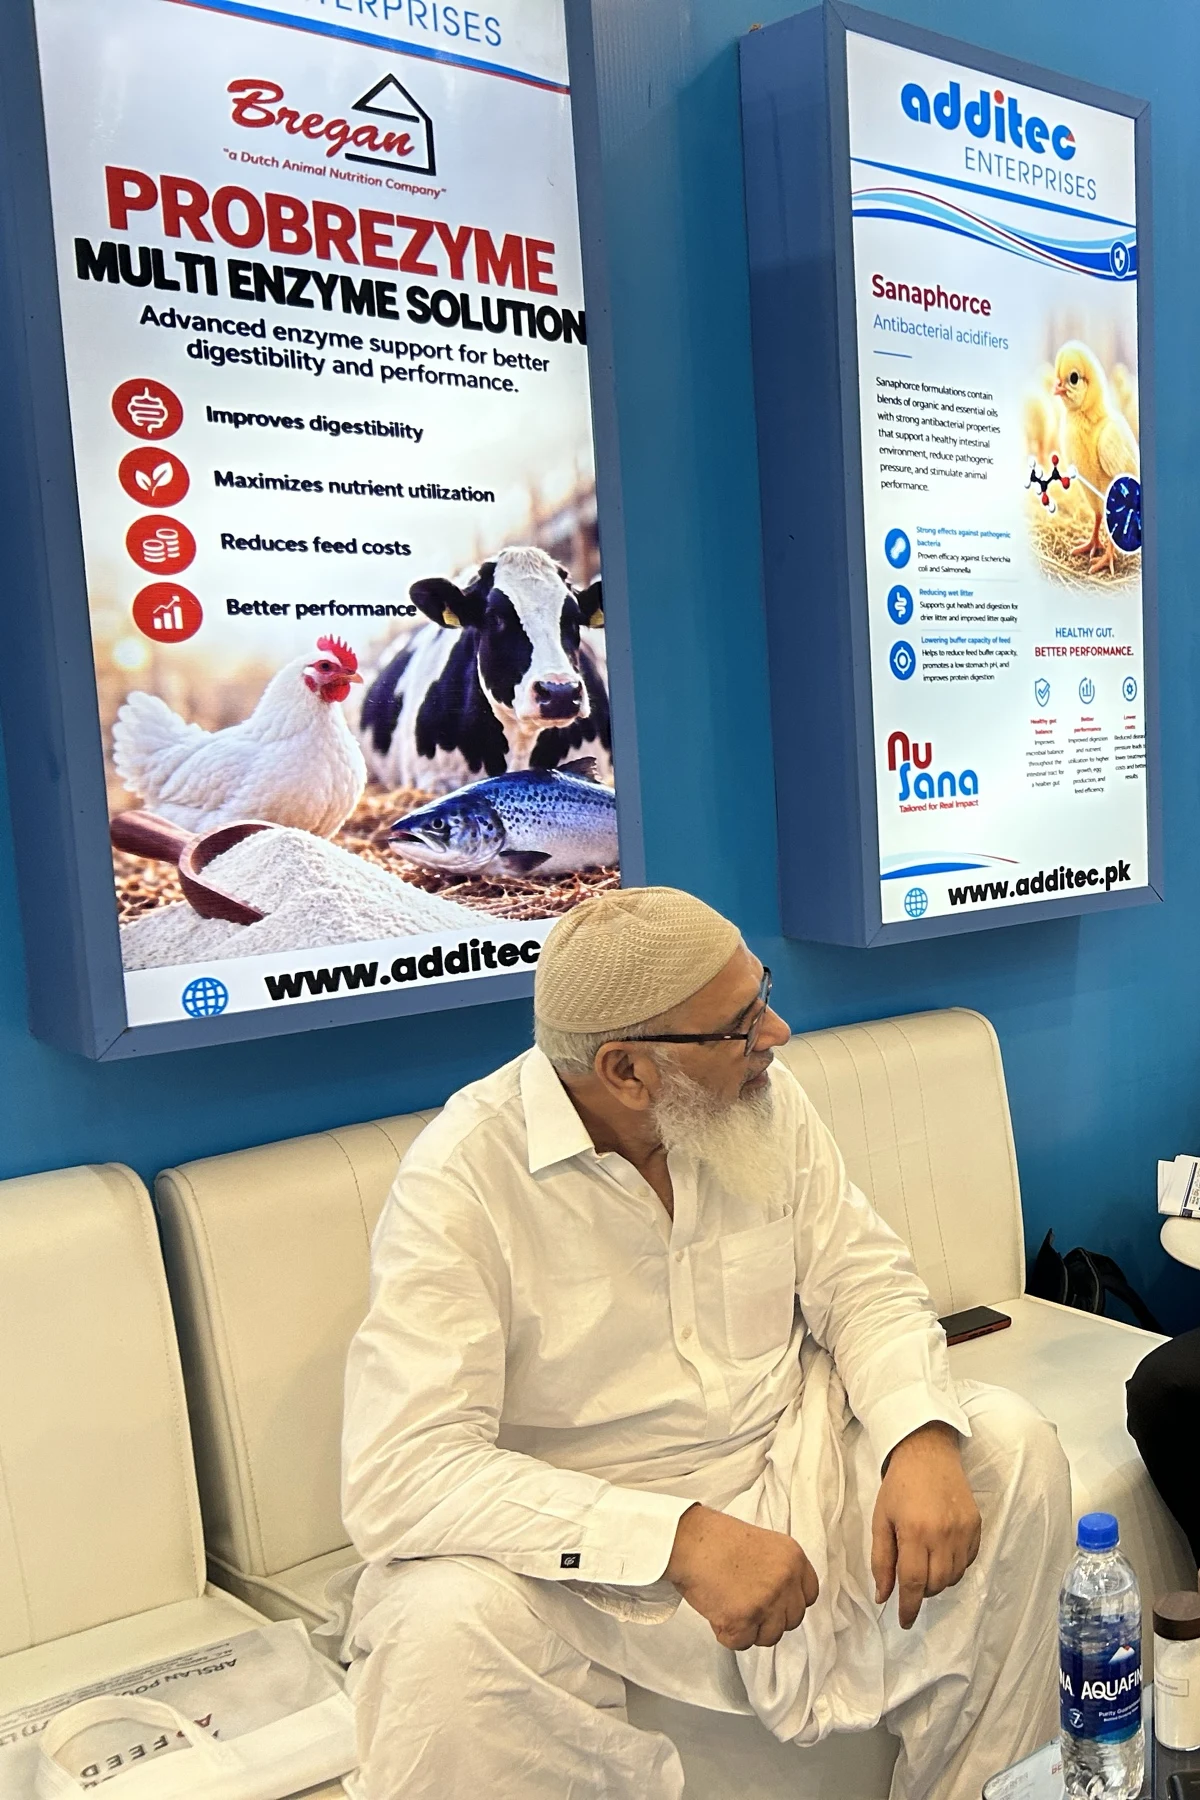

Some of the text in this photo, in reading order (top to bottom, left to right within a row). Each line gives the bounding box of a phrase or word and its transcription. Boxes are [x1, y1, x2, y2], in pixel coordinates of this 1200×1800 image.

[318, 0, 502, 47] RPRISES
[227, 79, 415, 158] Bregan
[900, 80, 1077, 161] additec
[240, 150, 279, 169] Dutch
[282, 160, 326, 177] Animal
[329, 167, 382, 188] Nutrition
[965, 146, 1097, 201] ENTERPRISES
[105, 165, 558, 296] PROBREZYME
[74, 237, 588, 345] MULTI ENZYME SOLUTION
[872, 273, 992, 317] Sanaphorce
[139, 304, 550, 372] Advanced enzyme support for better
[873, 313, 1009, 350] Antibacterial acidifiers
[186, 338, 519, 393] digestibility and performance.
[876, 376, 993, 401] Sanaphorce formulations contain
[877, 394, 998, 418] blends of organic and essential oils
[206, 405, 424, 443] Improves digestibility
[877, 411, 1001, 434] with strong antibacterial properties
[878, 428, 990, 448] that support a healthy intestinal
[879, 446, 994, 465] environment, reduce pathogenic
[880, 463, 987, 480] pressure, and stimulate animal
[214, 470, 495, 502] Maximizes nutrient utilization
[881, 480, 930, 491] performance.
[916, 526, 1011, 539] Strong effects against pathogenic
[917, 539, 941, 547] bacteria
[220, 533, 412, 556] Reduces feed costs
[917, 552, 938, 560] Proven
[939, 553, 959, 562] efficacy
[981, 555, 1011, 563] Escherichia
[919, 588, 947, 598] Reducing
[960, 589, 974, 597] litter
[226, 598, 417, 620] Better performance
[920, 601, 945, 610] Supports
[986, 603, 1010, 611] digestion
[960, 614, 986, 623] improved
[1000, 615, 1017, 623] quality
[921, 636, 948, 645] Lowering
[949, 636, 967, 644] buffer
[968, 637, 991, 645] capacity
[1055, 627, 1115, 638] HEALTHY GUT.
[921, 649, 938, 657] Helps
[1035, 645, 1134, 657] BETTER PERFORMANCE.
[922, 662, 949, 670] promotes
[923, 674, 995, 682] improves protein digestion
[899, 800, 978, 813] Tailored for Real Impact
[948, 860, 1131, 906] www.additec.pk
[264, 939, 542, 1001] www.additec
[164, 1658, 237, 1682] ARSLAN
[1081, 1665, 1142, 1701] AQUAFIN
[80, 1735, 169, 1778] FEED
